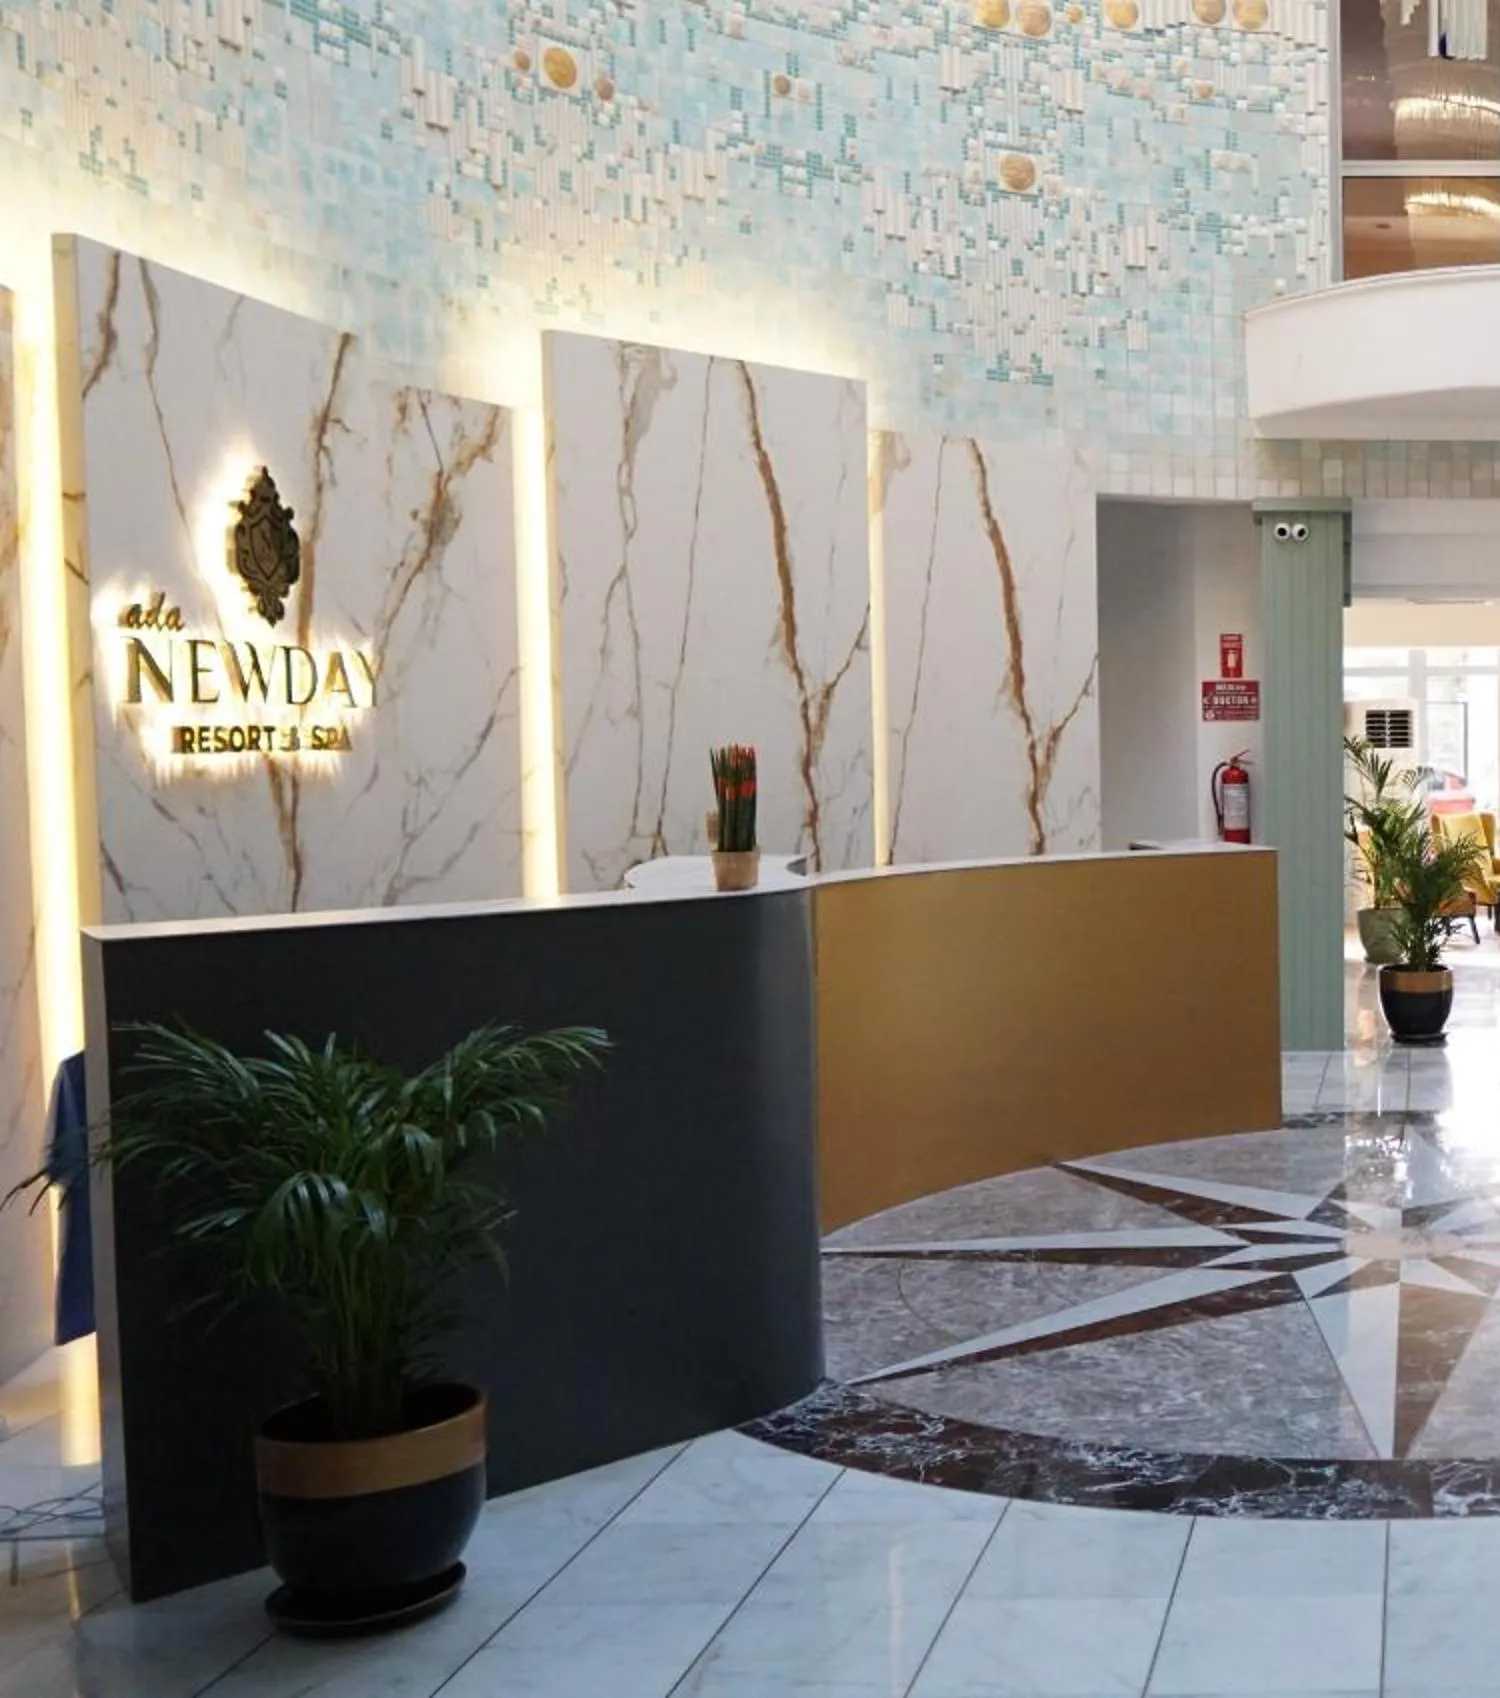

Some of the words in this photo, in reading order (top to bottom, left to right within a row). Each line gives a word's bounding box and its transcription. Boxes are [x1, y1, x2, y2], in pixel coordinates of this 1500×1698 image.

[118, 592, 184, 633] ada
[121, 636, 380, 708] NEWDAY
[175, 725, 276, 752] RESORT
[311, 725, 353, 751] SPA
